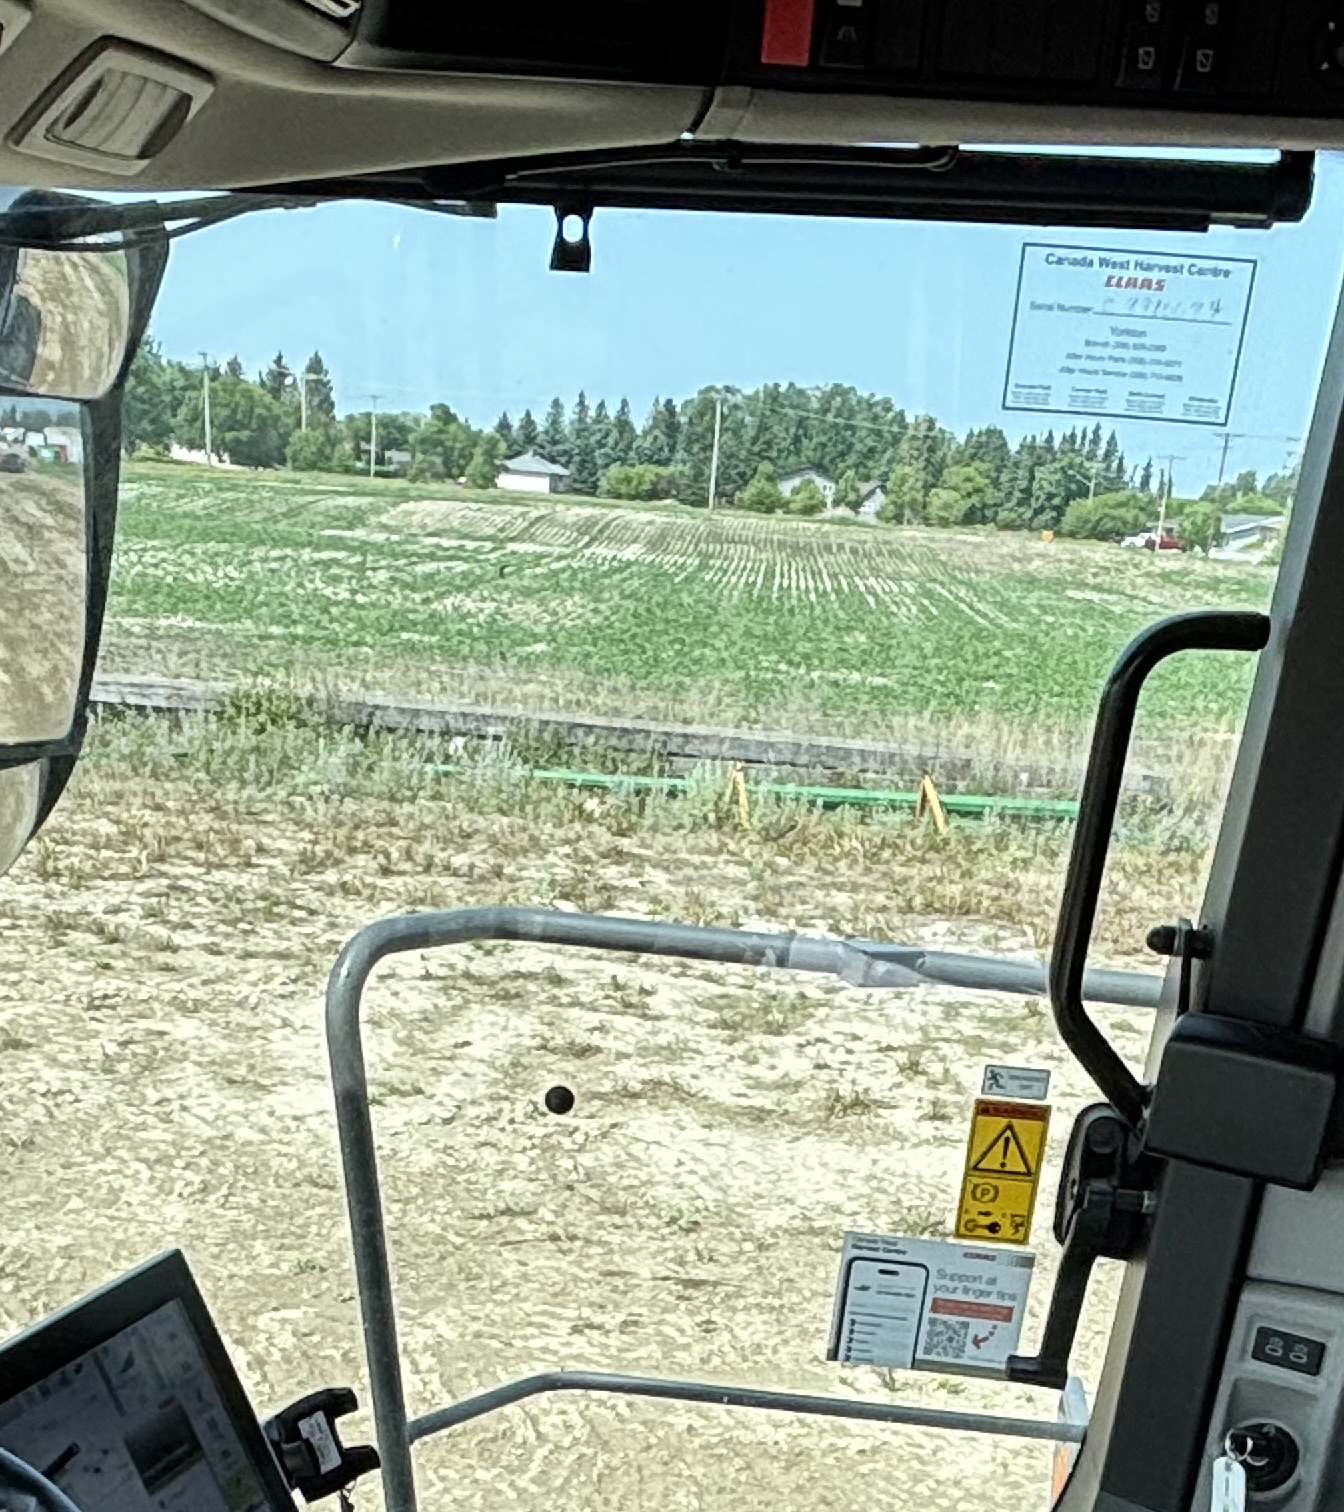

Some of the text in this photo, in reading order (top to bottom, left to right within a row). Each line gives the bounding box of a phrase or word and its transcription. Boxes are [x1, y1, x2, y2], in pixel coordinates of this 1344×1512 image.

[1045, 253, 1232, 279] Canada West Harvest Centre
[1104, 274, 1167, 292] CLAAS
[935, 1268, 983, 1286] Support
[932, 1282, 960, 1295] your
[961, 1284, 993, 1299] finger
